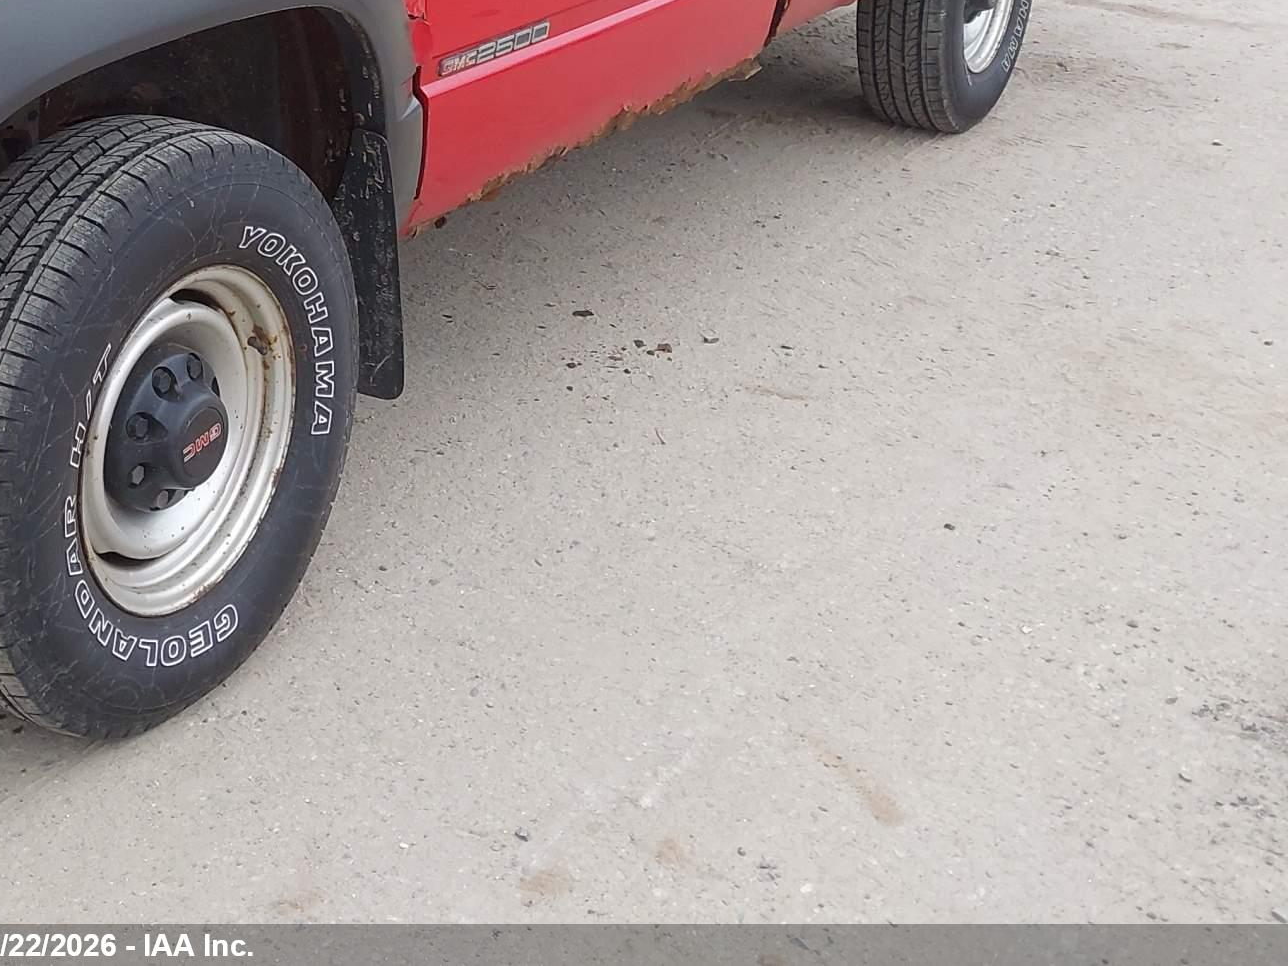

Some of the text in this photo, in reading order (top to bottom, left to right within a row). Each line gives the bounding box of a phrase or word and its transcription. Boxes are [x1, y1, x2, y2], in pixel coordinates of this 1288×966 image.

[238, 225, 336, 436] YOKOHAMA
[182, 422, 222, 463] GMC
[63, 493, 239, 668] GEOLANDAR
